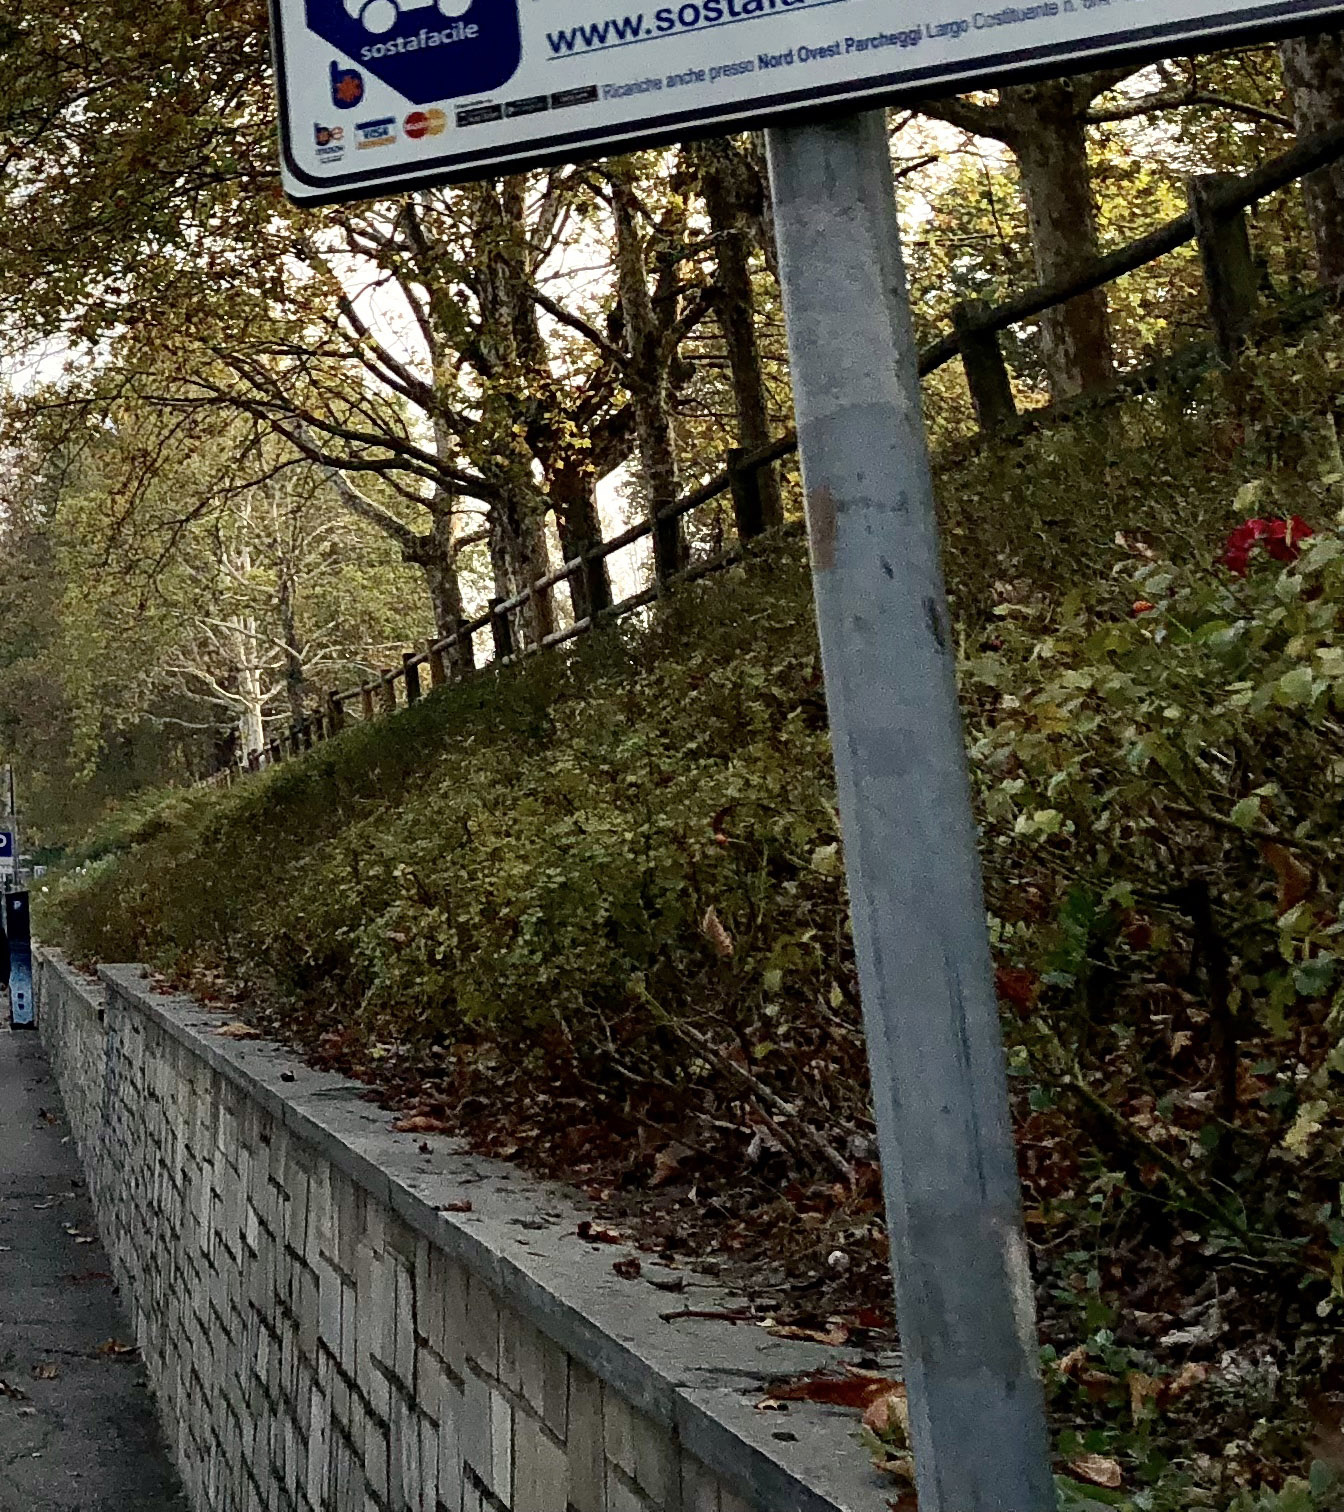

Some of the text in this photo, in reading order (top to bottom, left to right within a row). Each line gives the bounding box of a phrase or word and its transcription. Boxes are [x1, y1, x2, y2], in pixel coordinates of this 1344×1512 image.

[359, 21, 480, 62] sostafacile
[666, 67, 706, 88] anche
[709, 59, 755, 85] presso
[757, 48, 794, 71] Nord
[797, 39, 842, 63] Ovest
[844, 23, 923, 54] Parcheggi
[926, 19, 969, 39] Largo
